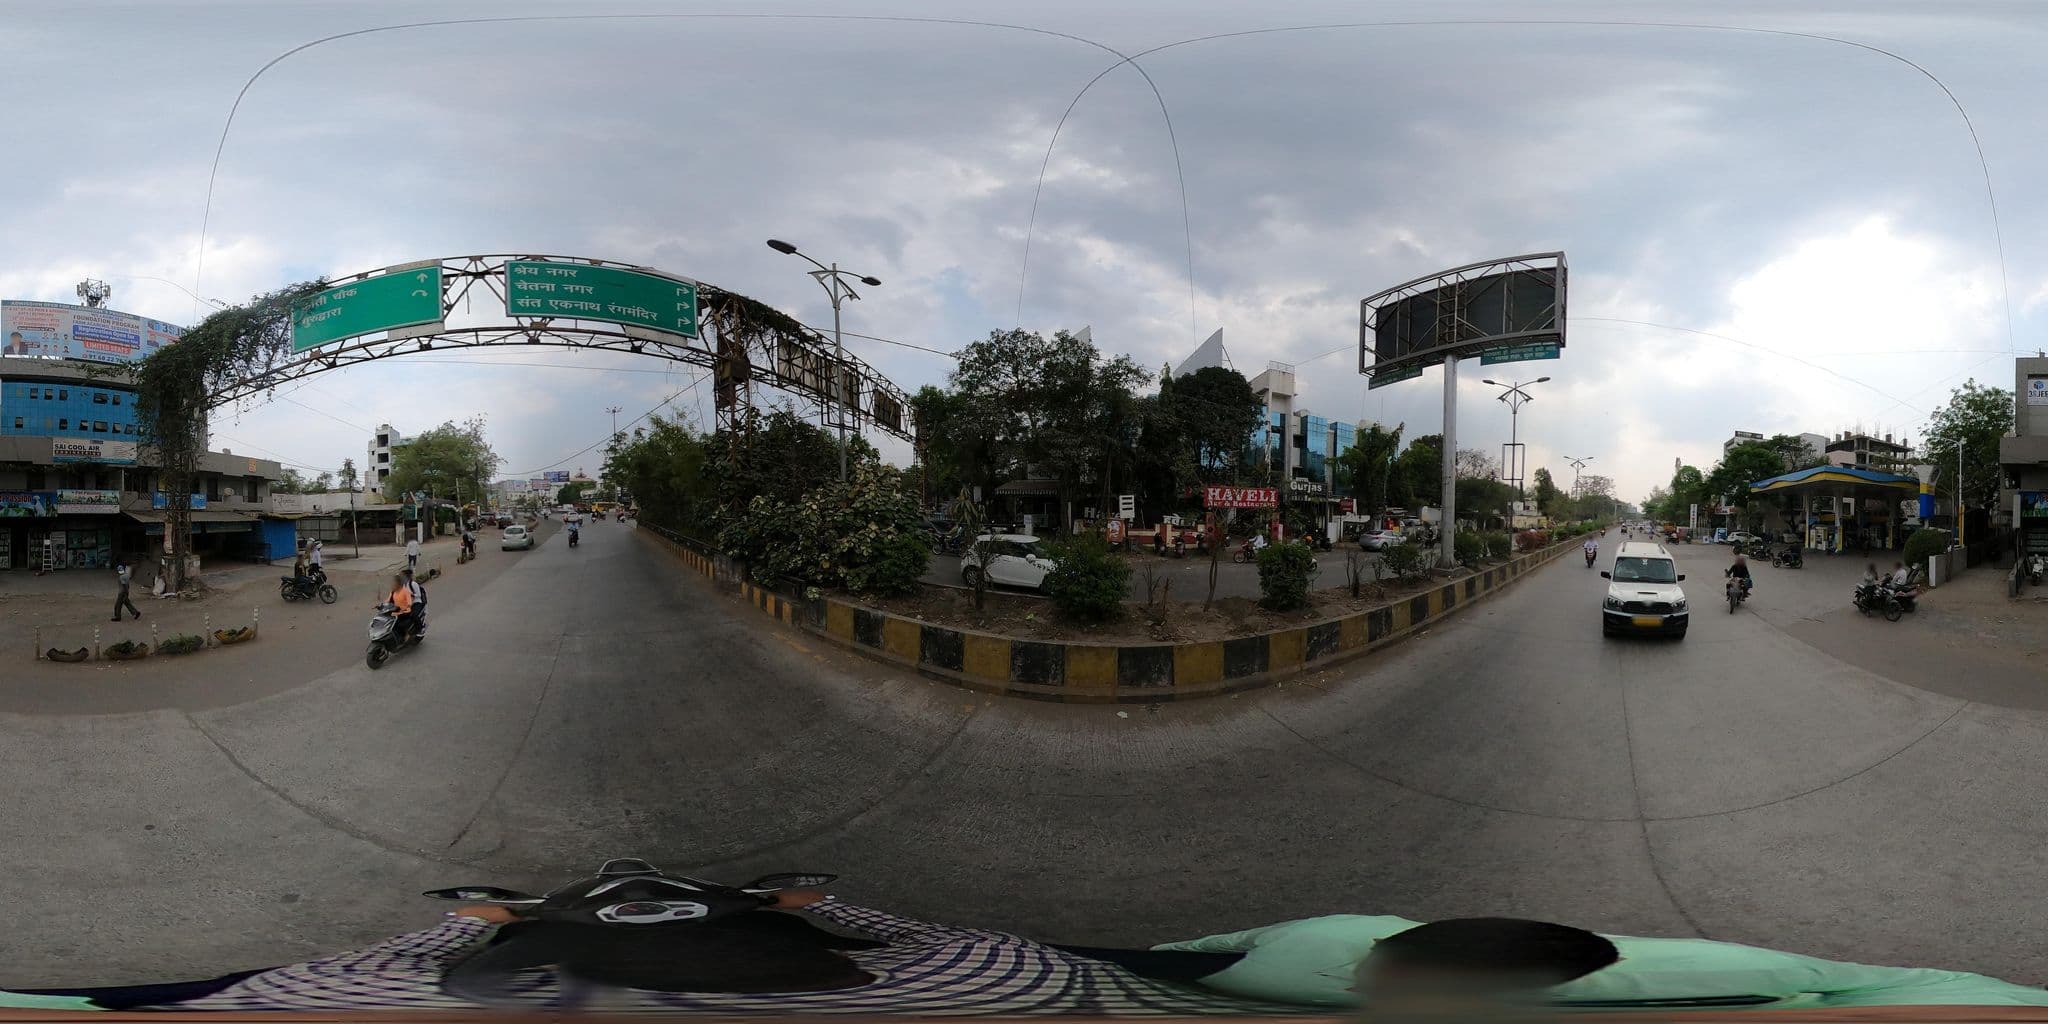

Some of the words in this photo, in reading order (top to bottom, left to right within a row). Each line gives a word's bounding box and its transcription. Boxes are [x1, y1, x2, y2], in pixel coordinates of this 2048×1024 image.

[514, 265, 539, 276] श्रेय
[545, 268, 578, 277] नगर
[515, 280, 556, 292] चेतना
[562, 283, 594, 295] नगर
[516, 296, 542, 308] संत
[548, 299, 601, 312] एकनाथ
[607, 303, 658, 321] रंगमंदिर
[73, 314, 111, 325] FOUNDATION
[1290, 481, 1322, 493] Gurjas
[1207, 488, 1276, 502] HAVELI
